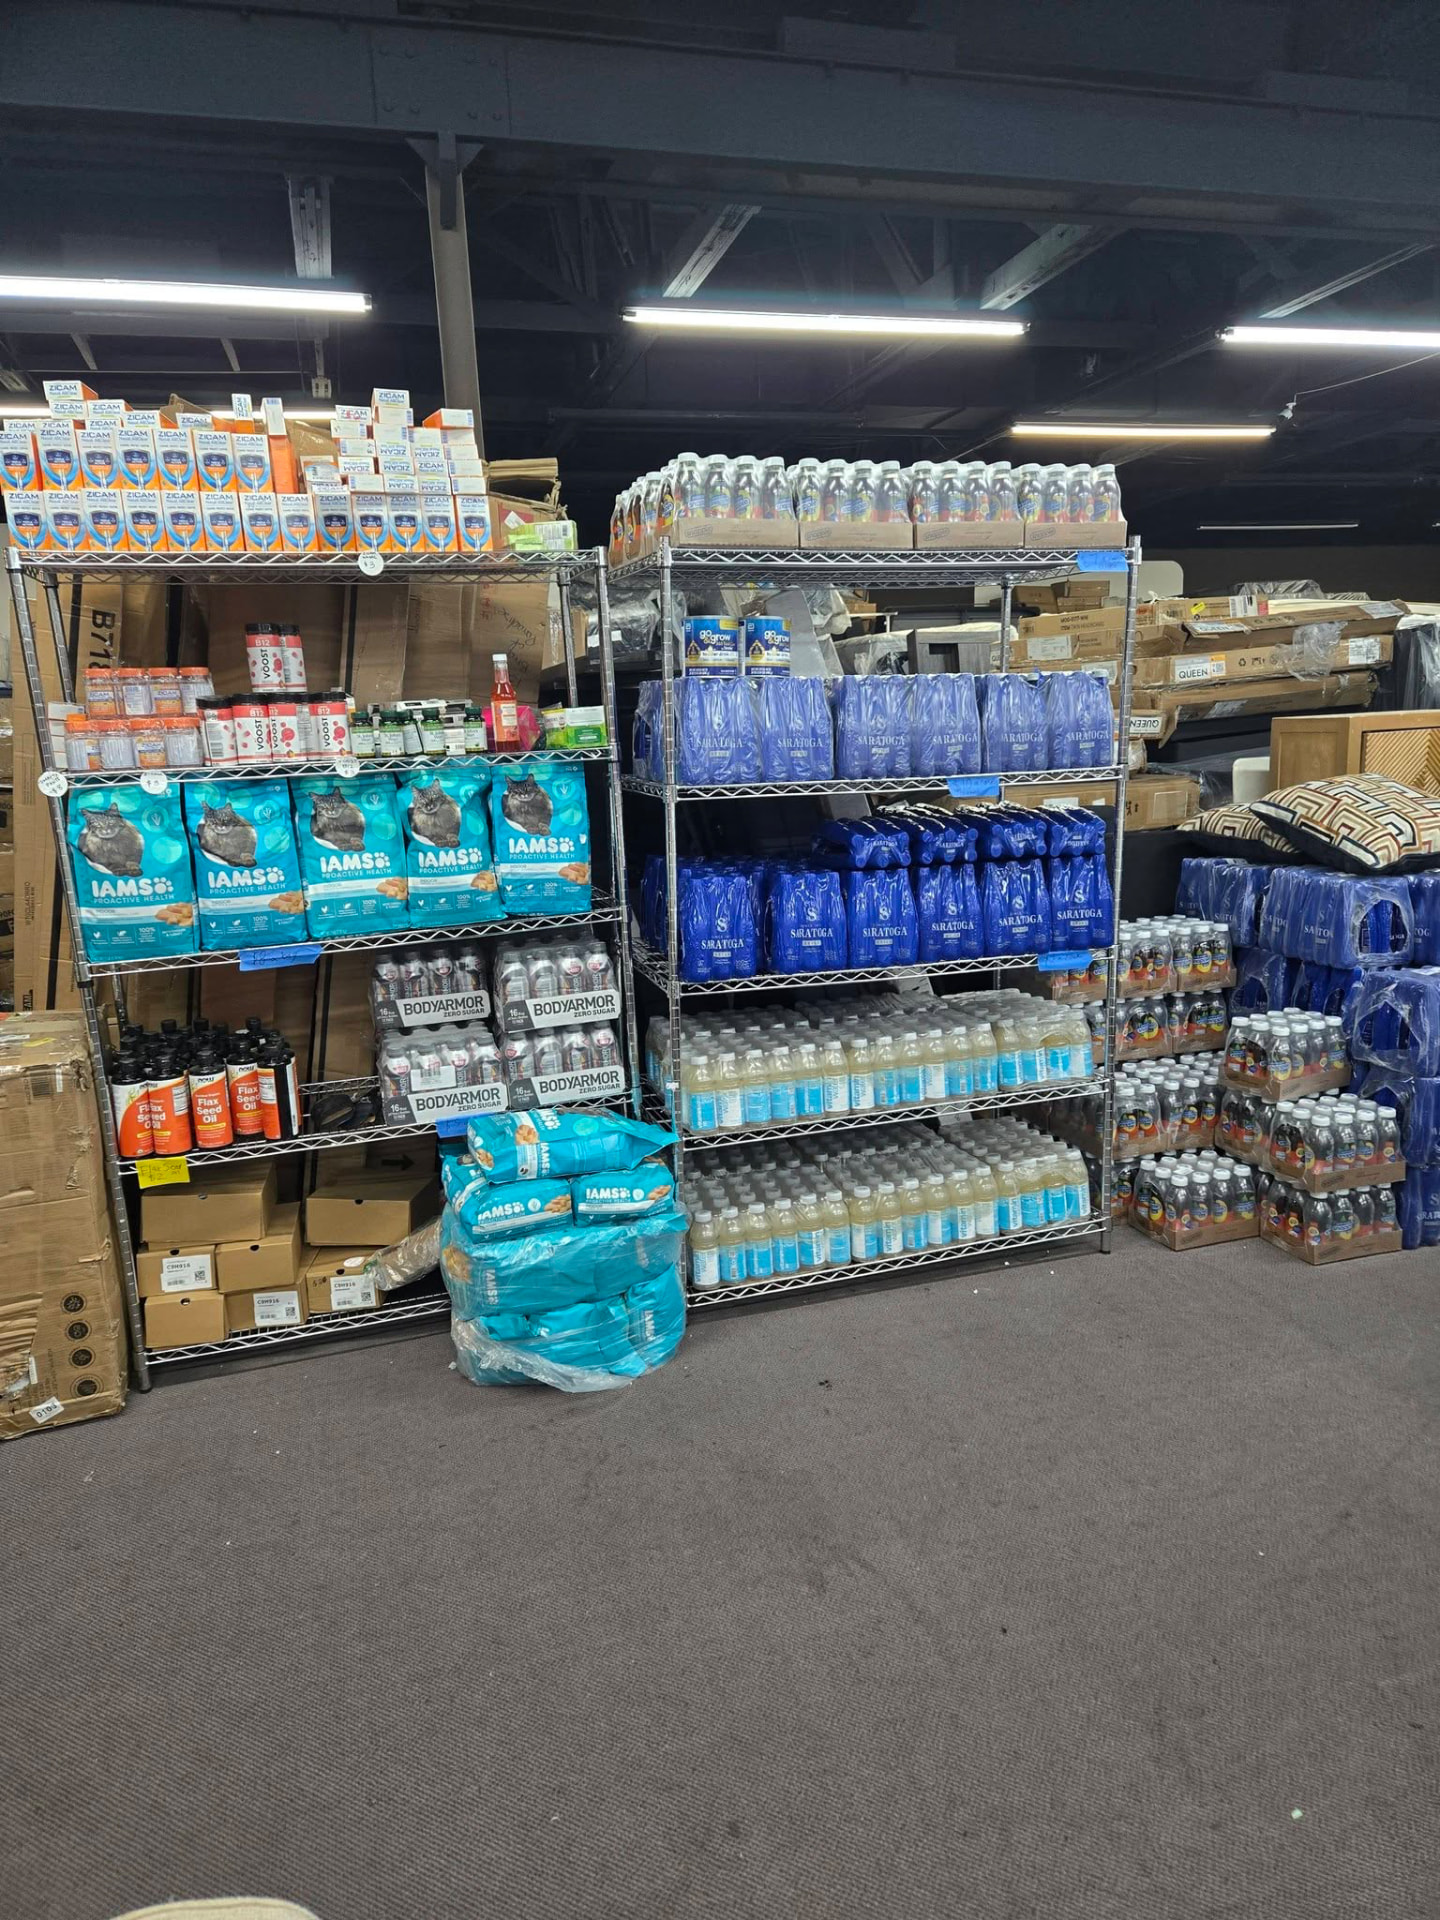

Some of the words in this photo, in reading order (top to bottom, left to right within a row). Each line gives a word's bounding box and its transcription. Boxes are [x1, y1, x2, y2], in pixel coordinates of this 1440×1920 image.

[379, 392, 405, 400] ZICAM
[81, 431, 111, 439] ZICAM
[158, 430, 187, 438] ZICAM
[235, 435, 264, 443] ZICAM
[48, 492, 79, 500] ZICAM
[205, 493, 233, 501] ZICAM
[260, 649, 271, 679] VOOST
[1179, 668, 1209, 679] QUEEN
[249, 709, 265, 717] B12
[317, 707, 331, 715] B12
[1130, 718, 1160, 728] QUEEN
[254, 719, 265, 750] VOOST
[271, 718, 279, 749] VOOST
[321, 717, 331, 747] VOOST
[777, 737, 823, 748] SARATOGA
[933, 733, 979, 745] SARATOGA
[508, 838, 559, 854] IAMS
[320, 852, 375, 873] IAMS
[418, 849, 470, 868] IAMS
[419, 866, 459, 874] PROACTIVE
[461, 863, 483, 871] HEALTH
[208, 869, 267, 888] IAMS
[321, 870, 363, 879] PROACTIVE
[91, 878, 154, 898] IAMS
[209, 886, 255, 895] PROACTIVE
[257, 883, 286, 892] HEALTH
[93, 896, 142, 905] PROACTIVE
[143, 894, 175, 902] HEALTH
[998, 914, 1043, 927] SARATOGA
[1056, 909, 1103, 921] SARATOGA
[863, 926, 908, 938] SARATOGA
[931, 921, 975, 932] SARATOGA
[790, 928, 833, 939] SARATOGA
[701, 939, 744, 950] SARATOGA
[404, 996, 484, 1016] BODYARMOR
[533, 994, 616, 1016] BODYARMOR
[379, 1008, 388, 1016] 16
[443, 1010, 462, 1018] ZERO
[462, 1008, 485, 1016] SUGAR
[509, 1008, 518, 1017] 16
[573, 1010, 592, 1018] ZERO
[592, 1007, 616, 1016] SUGAR
[539, 1070, 620, 1094] BODYARMOR
[237, 1086, 259, 1095] Flax
[515, 1086, 524, 1095] 16
[579, 1086, 597, 1094] ZERO
[197, 1098, 219, 1107] Flax
[416, 1087, 501, 1112] BODYARMOR
[196, 1105, 222, 1115] Seed
[243, 1102, 257, 1111] Oil
[390, 1104, 400, 1113] 16
[458, 1104, 477, 1112] ZERO
[477, 1100, 502, 1109] SUGAR
[202, 1114, 218, 1124] Oil
[540, 1142, 550, 1170] IAMS
[586, 1187, 620, 1199] IAMS
[478, 1203, 512, 1221] IAMS
[959, 1207, 968, 1238] vitamin
[486, 1269, 498, 1297] IAMS
